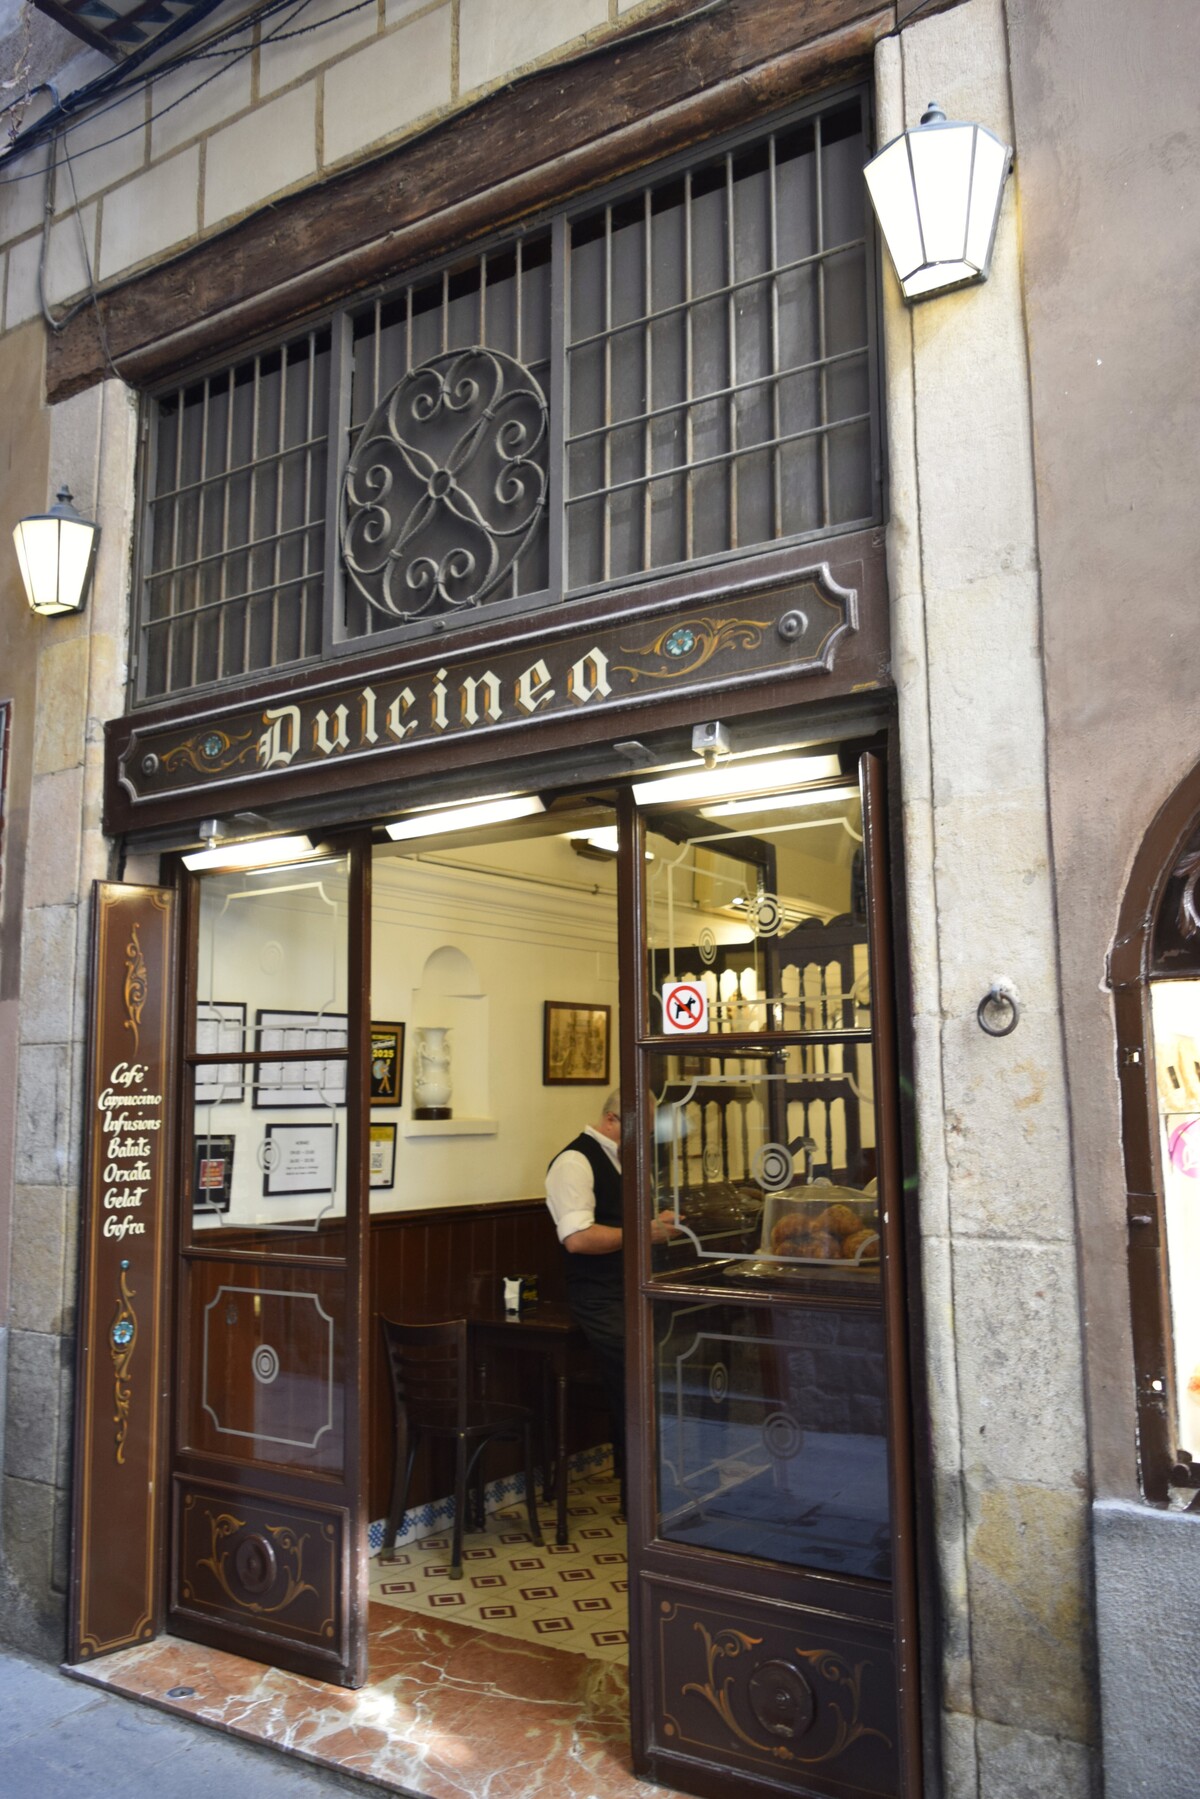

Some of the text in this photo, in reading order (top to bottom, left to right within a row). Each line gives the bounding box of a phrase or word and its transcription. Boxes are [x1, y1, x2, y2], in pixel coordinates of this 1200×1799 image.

[257, 646, 613, 769] Dulcinea
[110, 1062, 149, 1088] Café
[97, 1087, 162, 1110] Cappuccino
[103, 1110, 161, 1137] Infusions
[107, 1136, 151, 1159] Batuts
[103, 1160, 151, 1183] Orxata
[103, 1186, 149, 1209] Gelat
[103, 1215, 146, 1242] Gofra
